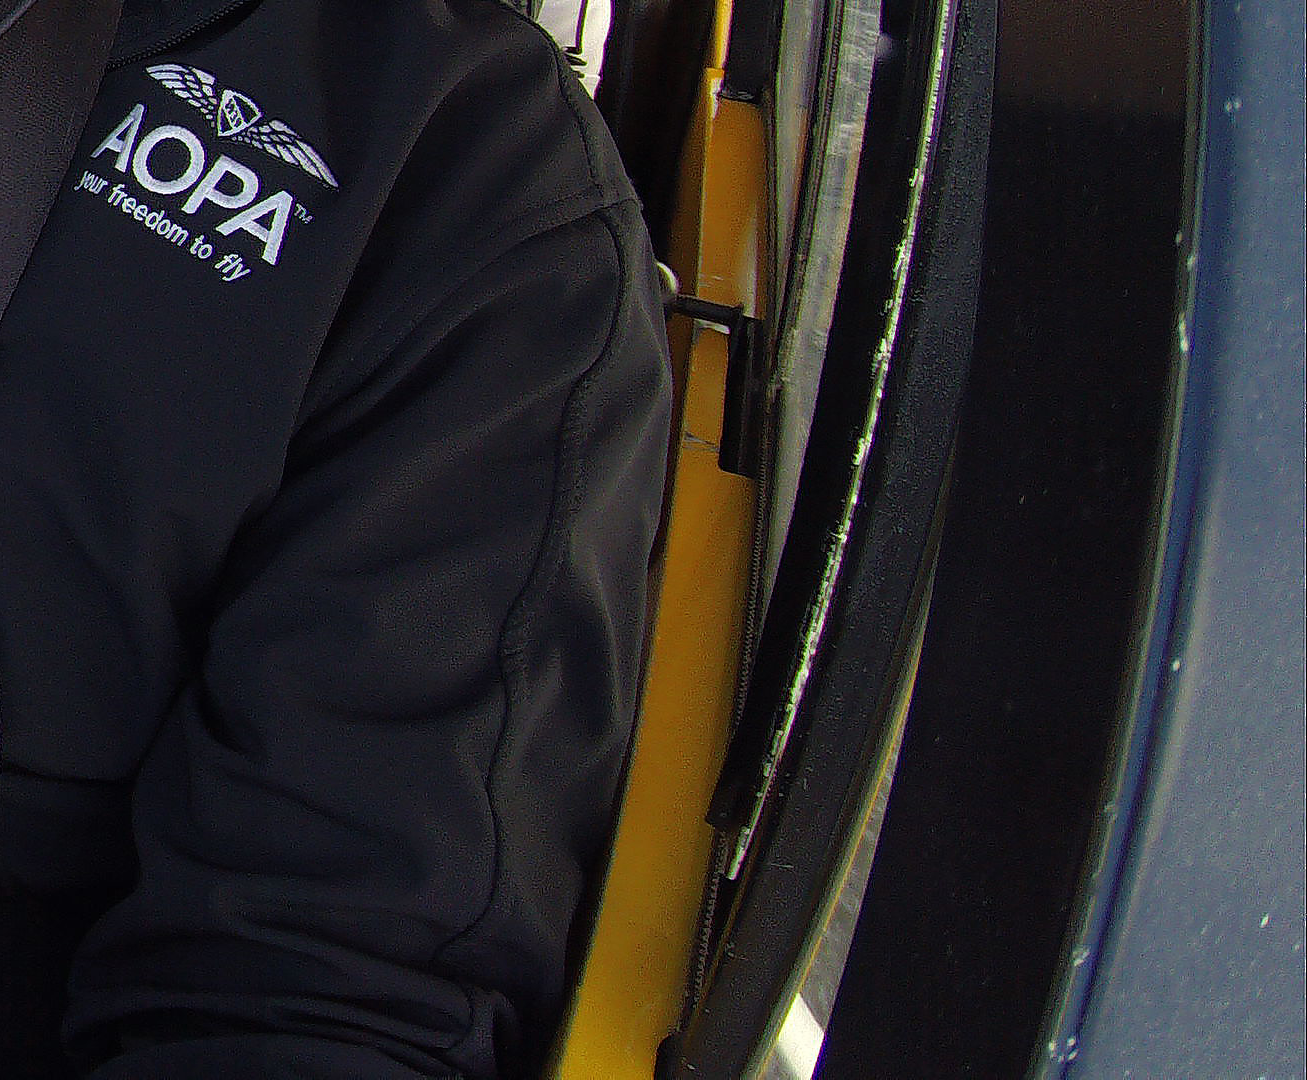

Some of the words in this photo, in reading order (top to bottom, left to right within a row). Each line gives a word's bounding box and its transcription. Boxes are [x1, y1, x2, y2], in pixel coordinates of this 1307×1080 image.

[73, 170, 108, 192] your
[108, 183, 189, 247] freedom
[190, 234, 213, 260] to
[215, 253, 252, 282] fly
[91, 103, 294, 265] AOPA
